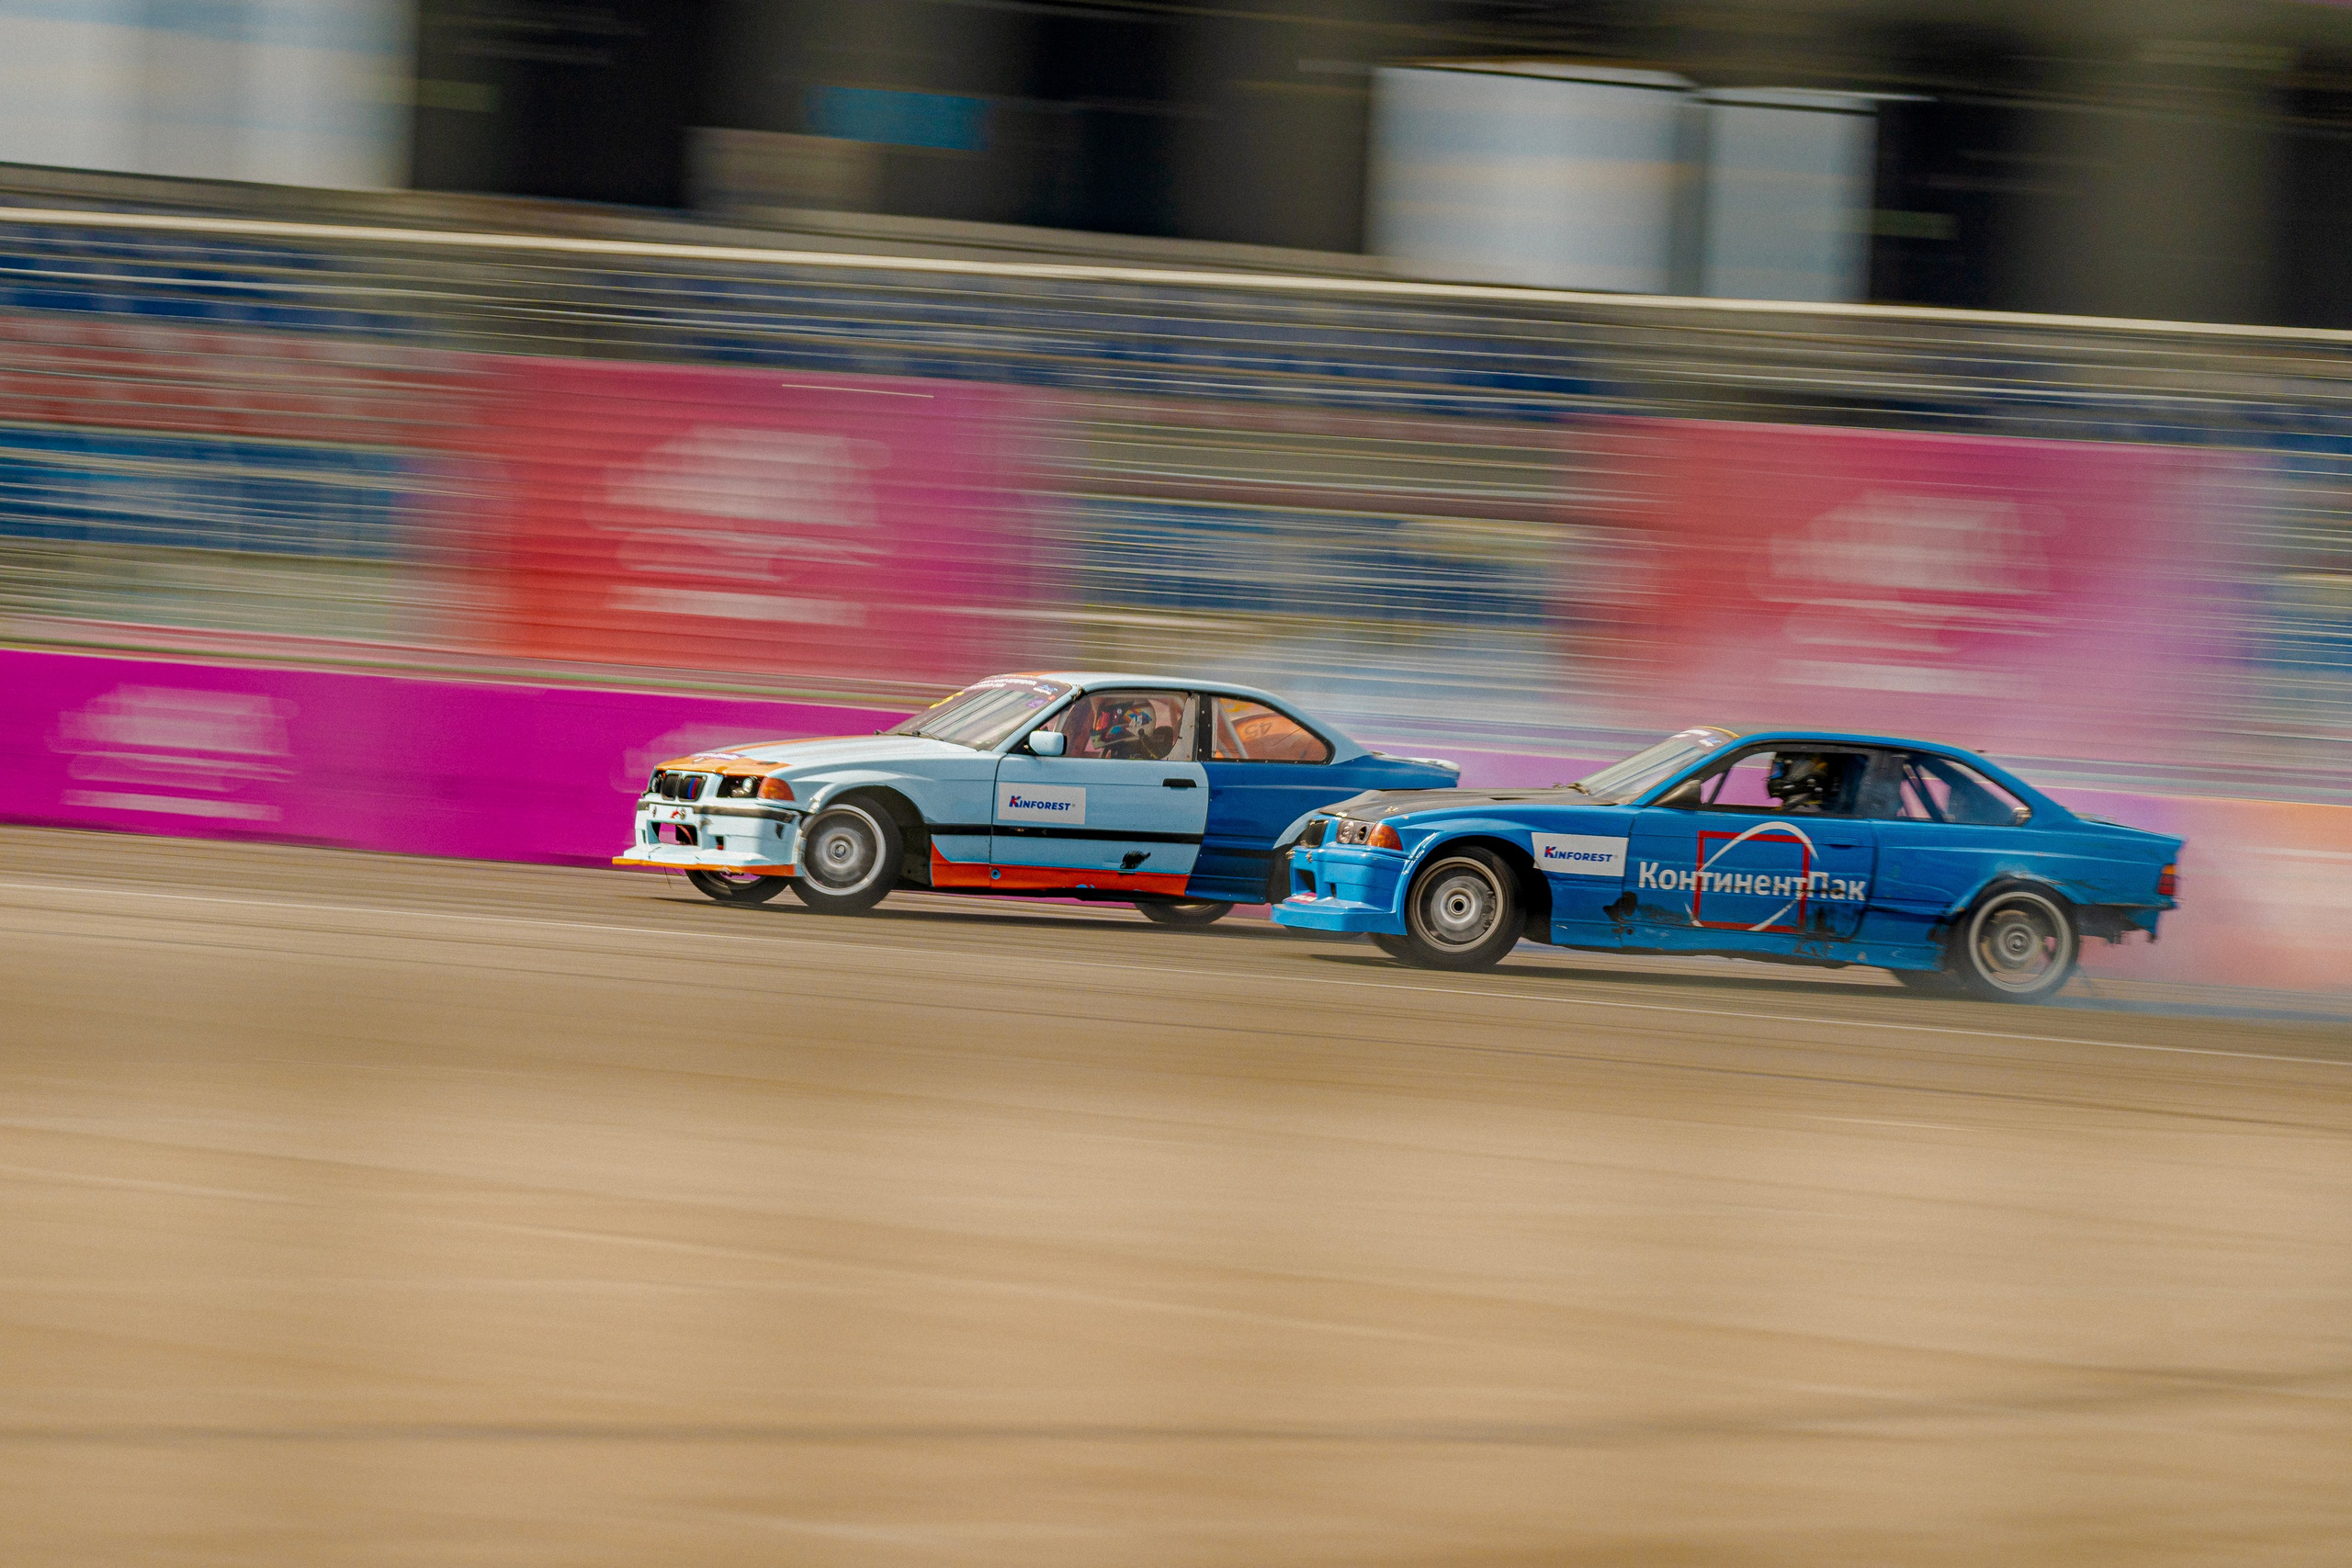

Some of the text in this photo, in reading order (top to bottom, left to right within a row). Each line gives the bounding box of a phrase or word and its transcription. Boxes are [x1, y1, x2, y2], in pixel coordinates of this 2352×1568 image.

[1009, 795, 1071, 811] KINFOREST
[1544, 845, 1613, 863] KINFOREST
[1638, 862, 1867, 901] КонтинентПак
